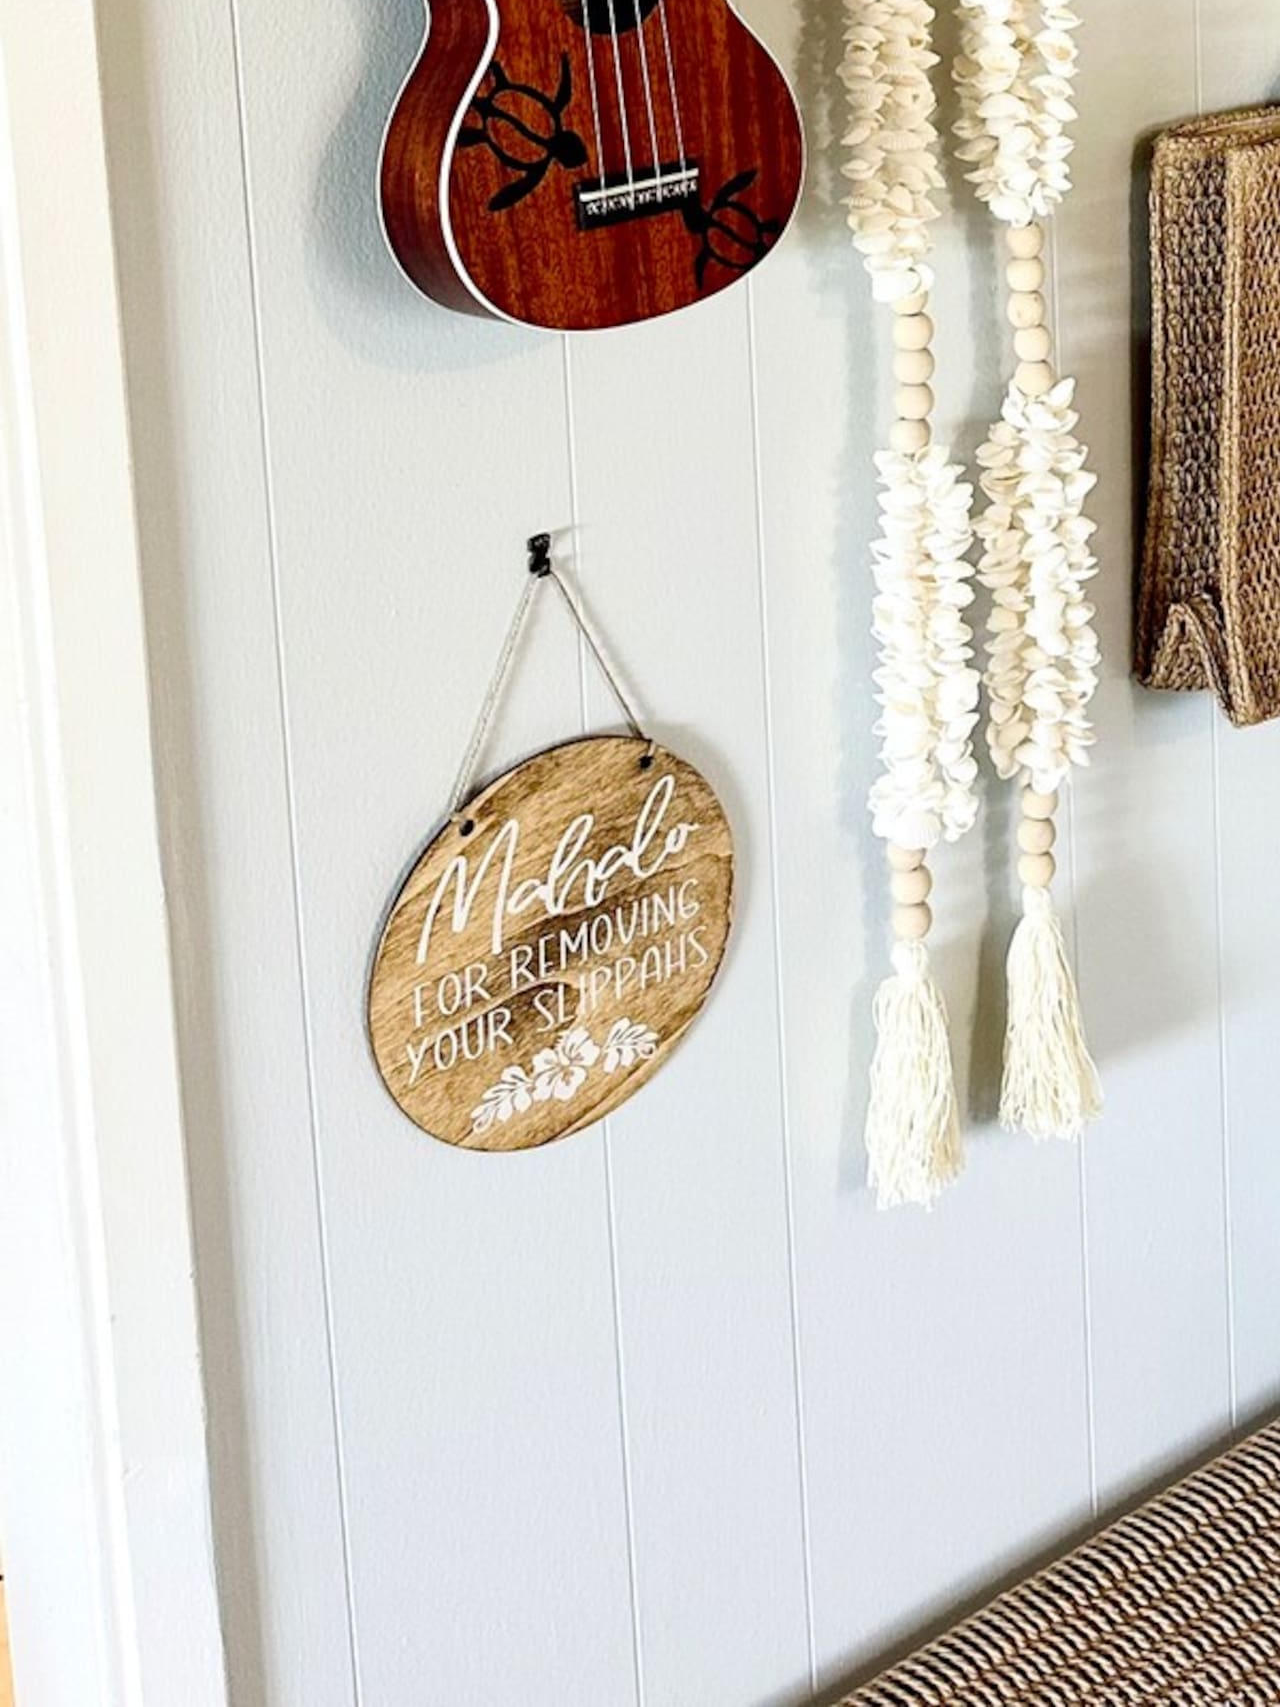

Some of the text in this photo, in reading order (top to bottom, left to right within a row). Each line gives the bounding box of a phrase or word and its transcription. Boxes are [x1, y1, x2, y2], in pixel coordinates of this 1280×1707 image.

[416, 774, 700, 964] Mahalo
[406, 926, 710, 1085] YOUR SLIPPAHS
[413, 878, 700, 1027] FOR REMOVING
